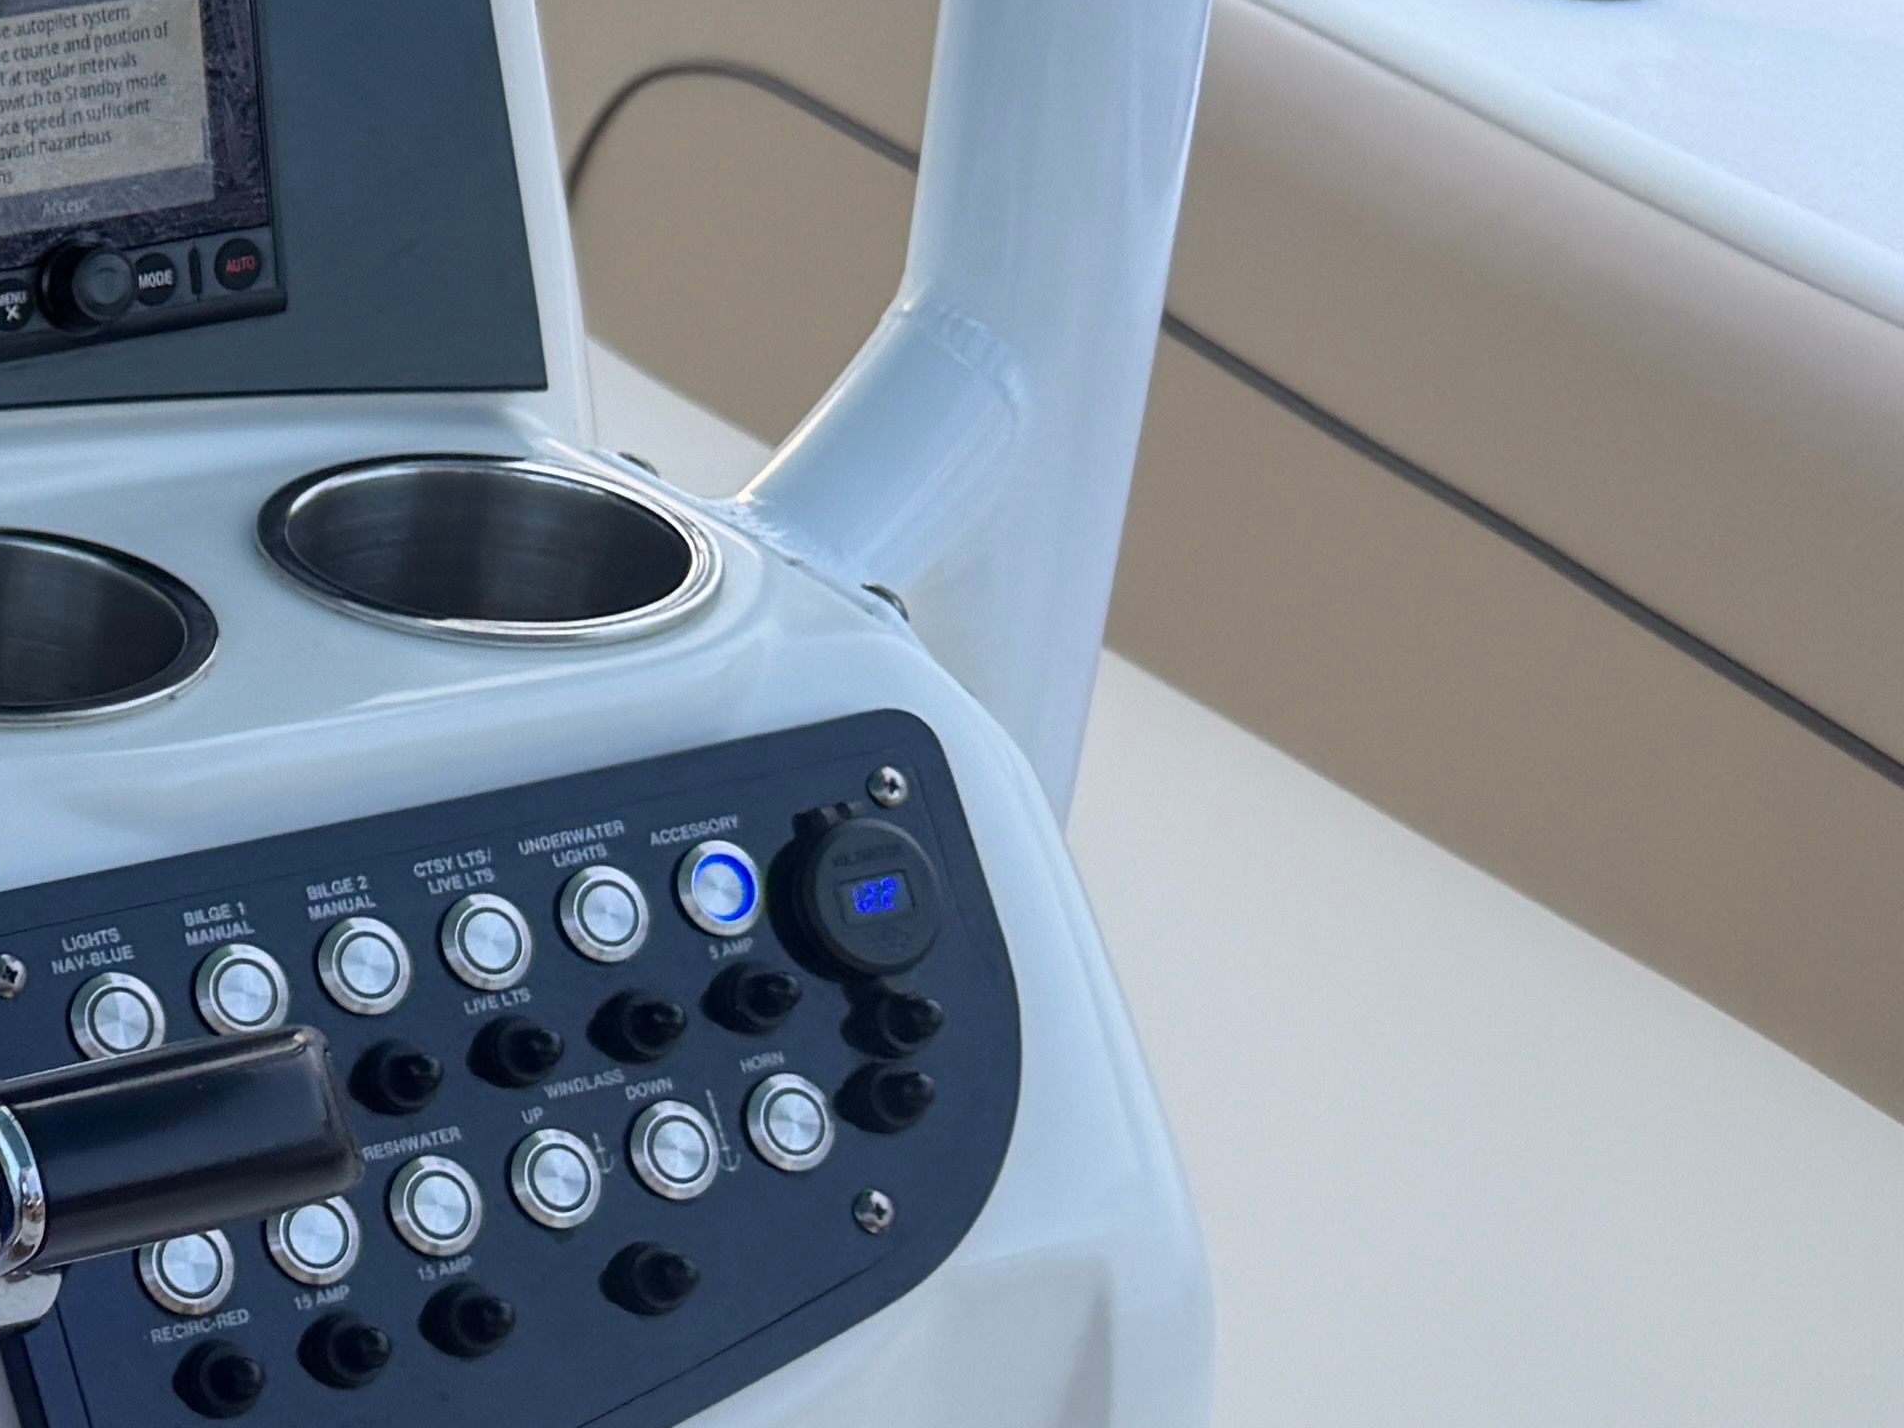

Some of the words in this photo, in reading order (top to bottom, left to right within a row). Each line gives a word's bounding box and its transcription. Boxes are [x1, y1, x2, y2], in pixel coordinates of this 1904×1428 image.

[82, 4, 130, 29] system
[13, 42, 57, 61] course
[63, 35, 89, 53] and
[93, 25, 149, 51] position
[138, 269, 173, 290] MODE
[226, 256, 256, 273] AUTO
[518, 820, 625, 856] UNDERWATER
[649, 814, 740, 846] ACCESSORY
[413, 857, 455, 879] CTSY
[552, 843, 608, 868] LIGHTS
[306, 880, 354, 901] BILGE
[358, 875, 369, 891] 2
[427, 874, 473, 895] LIVE
[476, 866, 496, 887] LTS
[183, 907, 231, 927] BILGE
[236, 902, 246, 917] 1
[307, 895, 376, 921] MANUAL
[62, 927, 121, 952] LIGHTS
[185, 920, 255, 946] MANUAL
[52, 944, 134, 974] NAV-BLUE
[710, 943, 720, 960] 5
[722, 936, 754, 956] AMP
[464, 995, 502, 1016] LIVE
[505, 987, 531, 1007] LTS
[740, 1051, 784, 1072] HORN
[544, 1069, 624, 1099] WINDLASS
[521, 1105, 544, 1126] UP
[625, 1078, 673, 1101] DOWN
[362, 1126, 462, 1161] RESHWATER
[417, 1266, 435, 1281] 15
[438, 1256, 472, 1276] AMP
[294, 1295, 312, 1310] 15
[315, 1284, 350, 1305] AMP
[150, 1308, 251, 1343] RECIRC-RED
